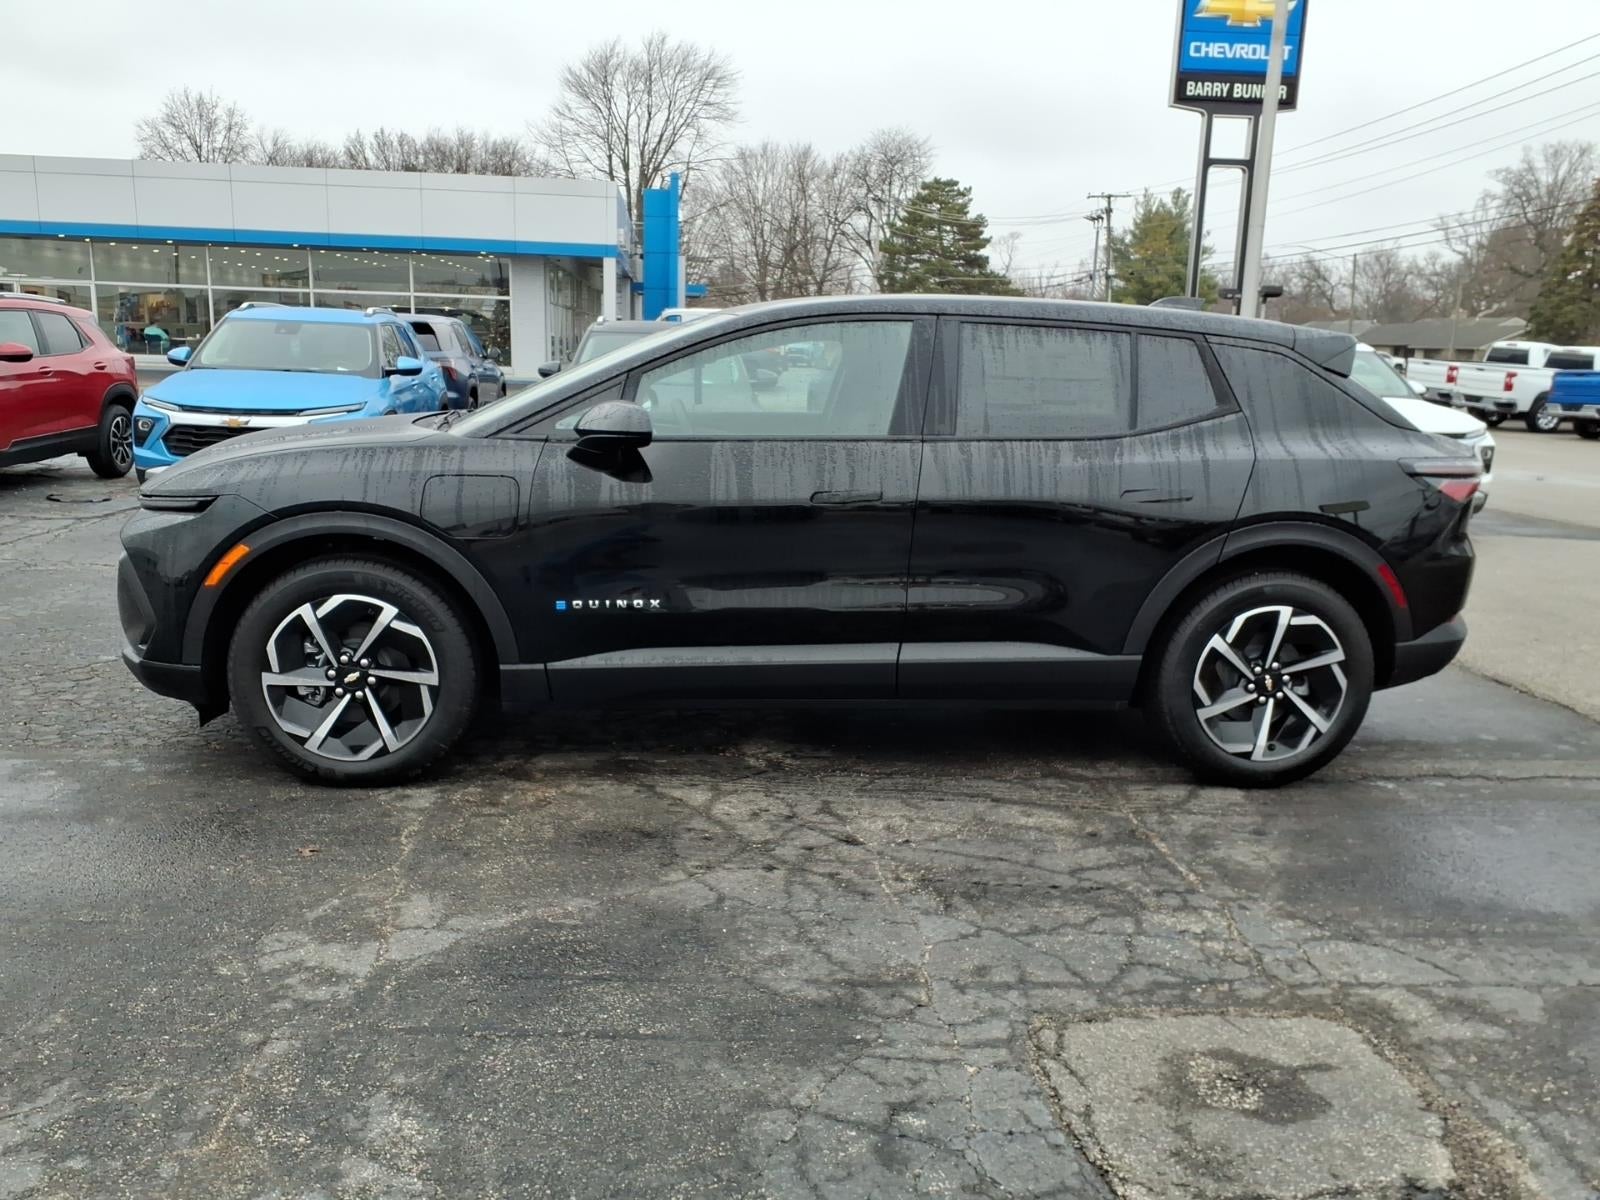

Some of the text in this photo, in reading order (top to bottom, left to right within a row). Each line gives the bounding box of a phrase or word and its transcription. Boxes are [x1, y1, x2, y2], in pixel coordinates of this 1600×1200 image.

[1189, 42, 1292, 60] CHEVROLT
[1186, 81, 1287, 99] BARRY BUNR
